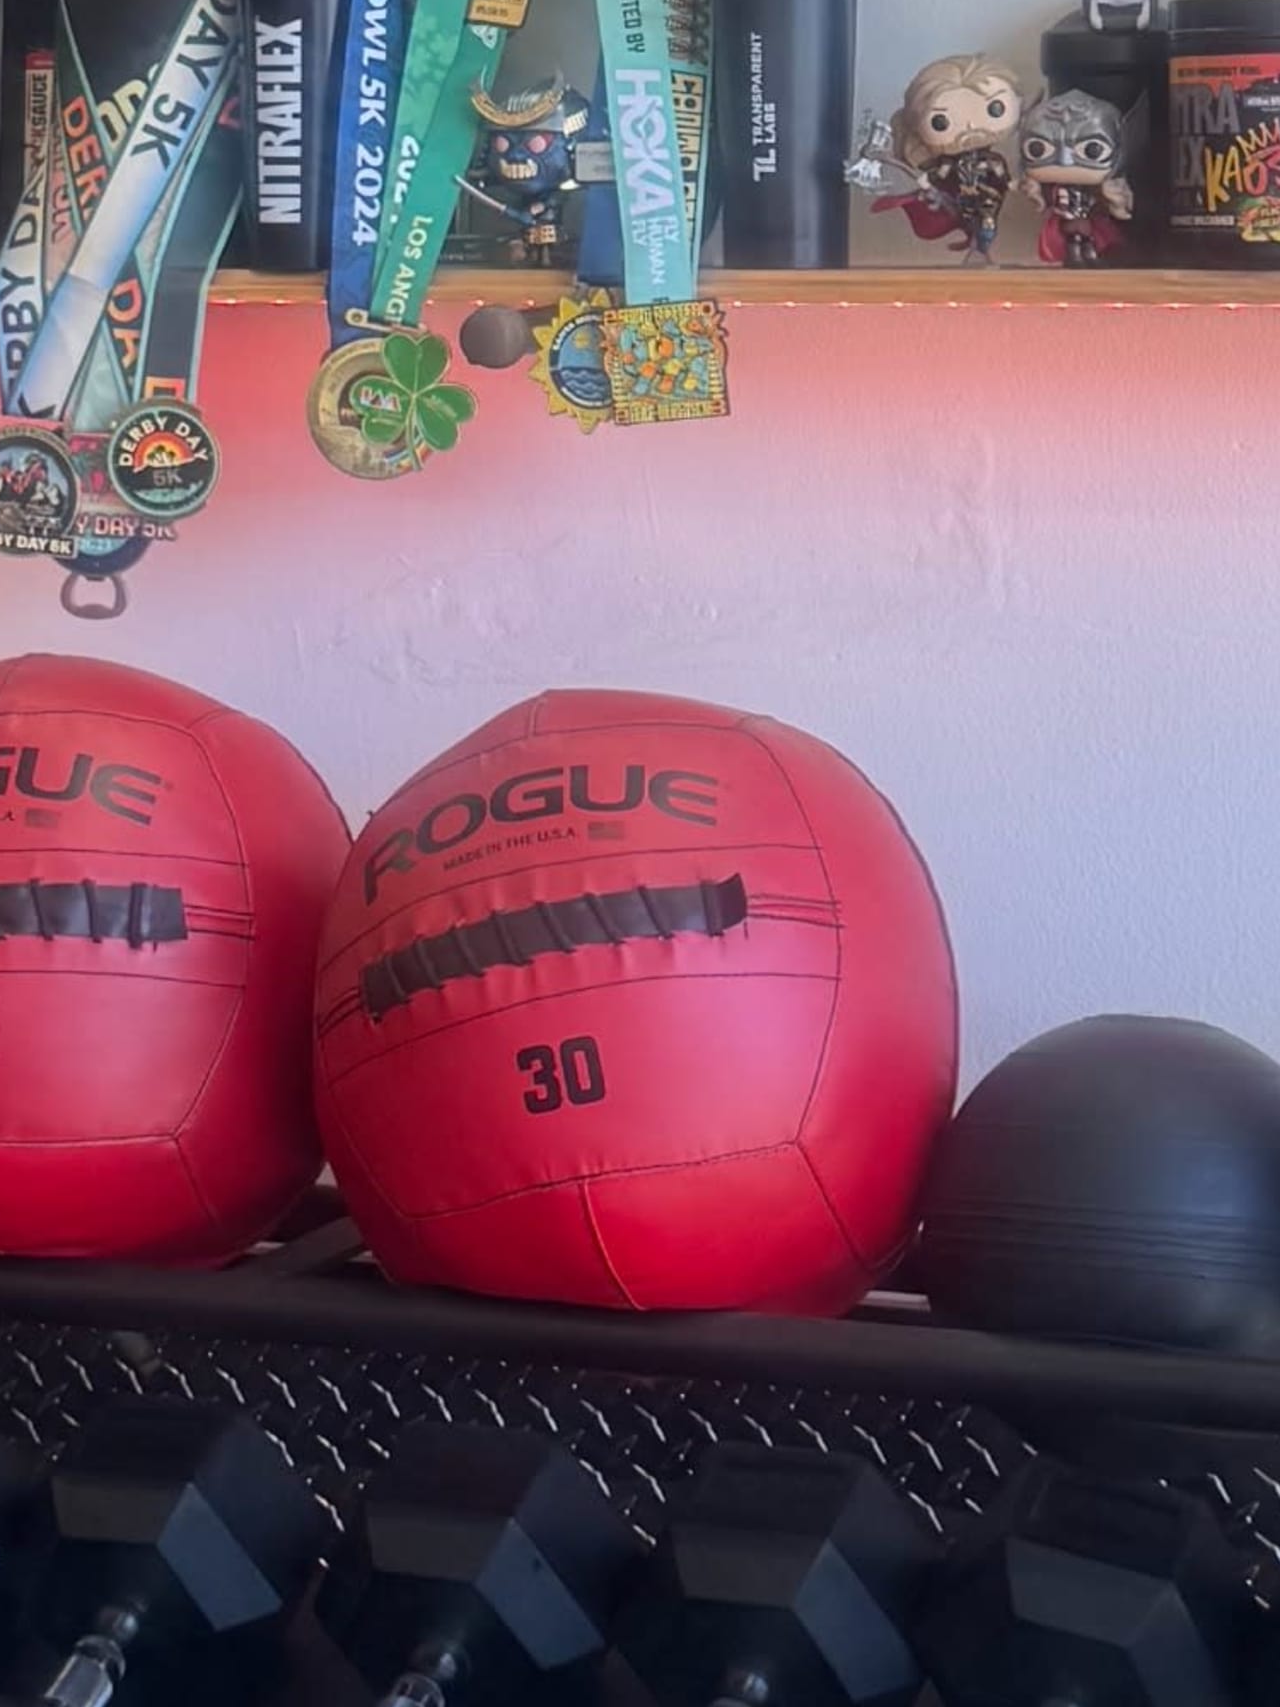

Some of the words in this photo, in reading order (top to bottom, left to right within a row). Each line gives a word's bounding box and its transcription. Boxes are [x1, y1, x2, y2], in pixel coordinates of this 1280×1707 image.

[626, 34, 646, 53] BY
[356, 76, 387, 130] 5K
[750, 32, 763, 146] TRANSPARENT
[130, 93, 196, 171] 5K
[256, 18, 303, 225] NITRAFLEX
[614, 70, 674, 215] HOKA
[764, 103, 777, 144] LABS
[351, 144, 387, 247] 2024
[404, 215, 434, 260] LOS
[119, 417, 168, 467] DERBY
[175, 422, 208, 461] DAY
[152, 468, 182, 486] 5K
[16, 535, 48, 552] DAY
[362, 765, 719, 906] ROGUE
[442, 848, 484, 871] MADE
[486, 841, 502, 855] IN
[506, 834, 531, 849] THE
[517, 1036, 606, 1115] 30
